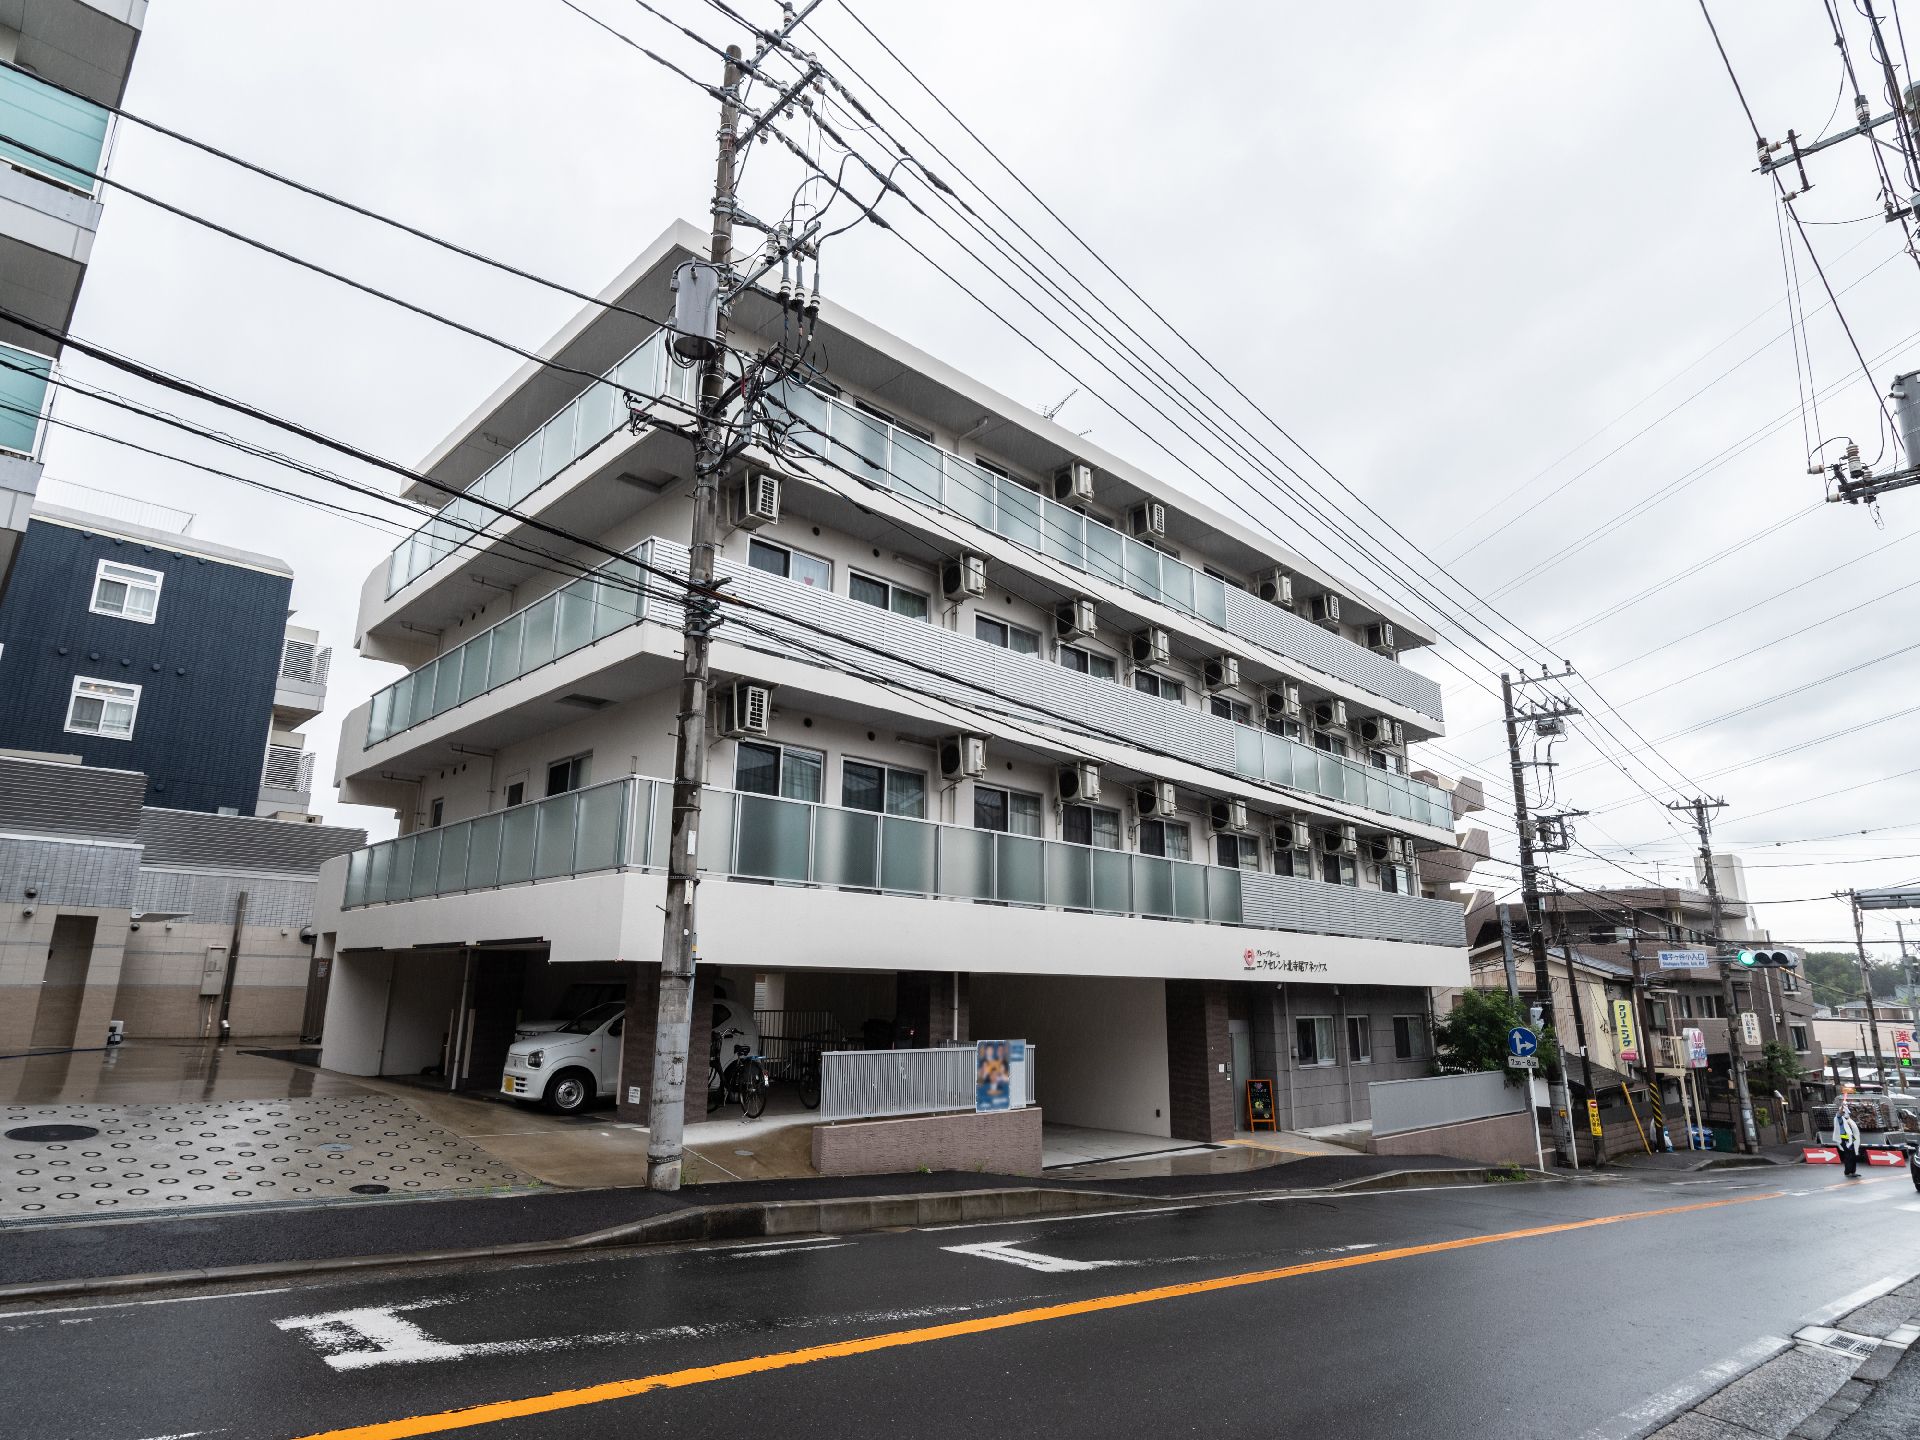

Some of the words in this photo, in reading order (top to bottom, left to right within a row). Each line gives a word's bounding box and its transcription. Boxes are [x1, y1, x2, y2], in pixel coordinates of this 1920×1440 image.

[1618, 1004, 1632, 1047] クリーニング
